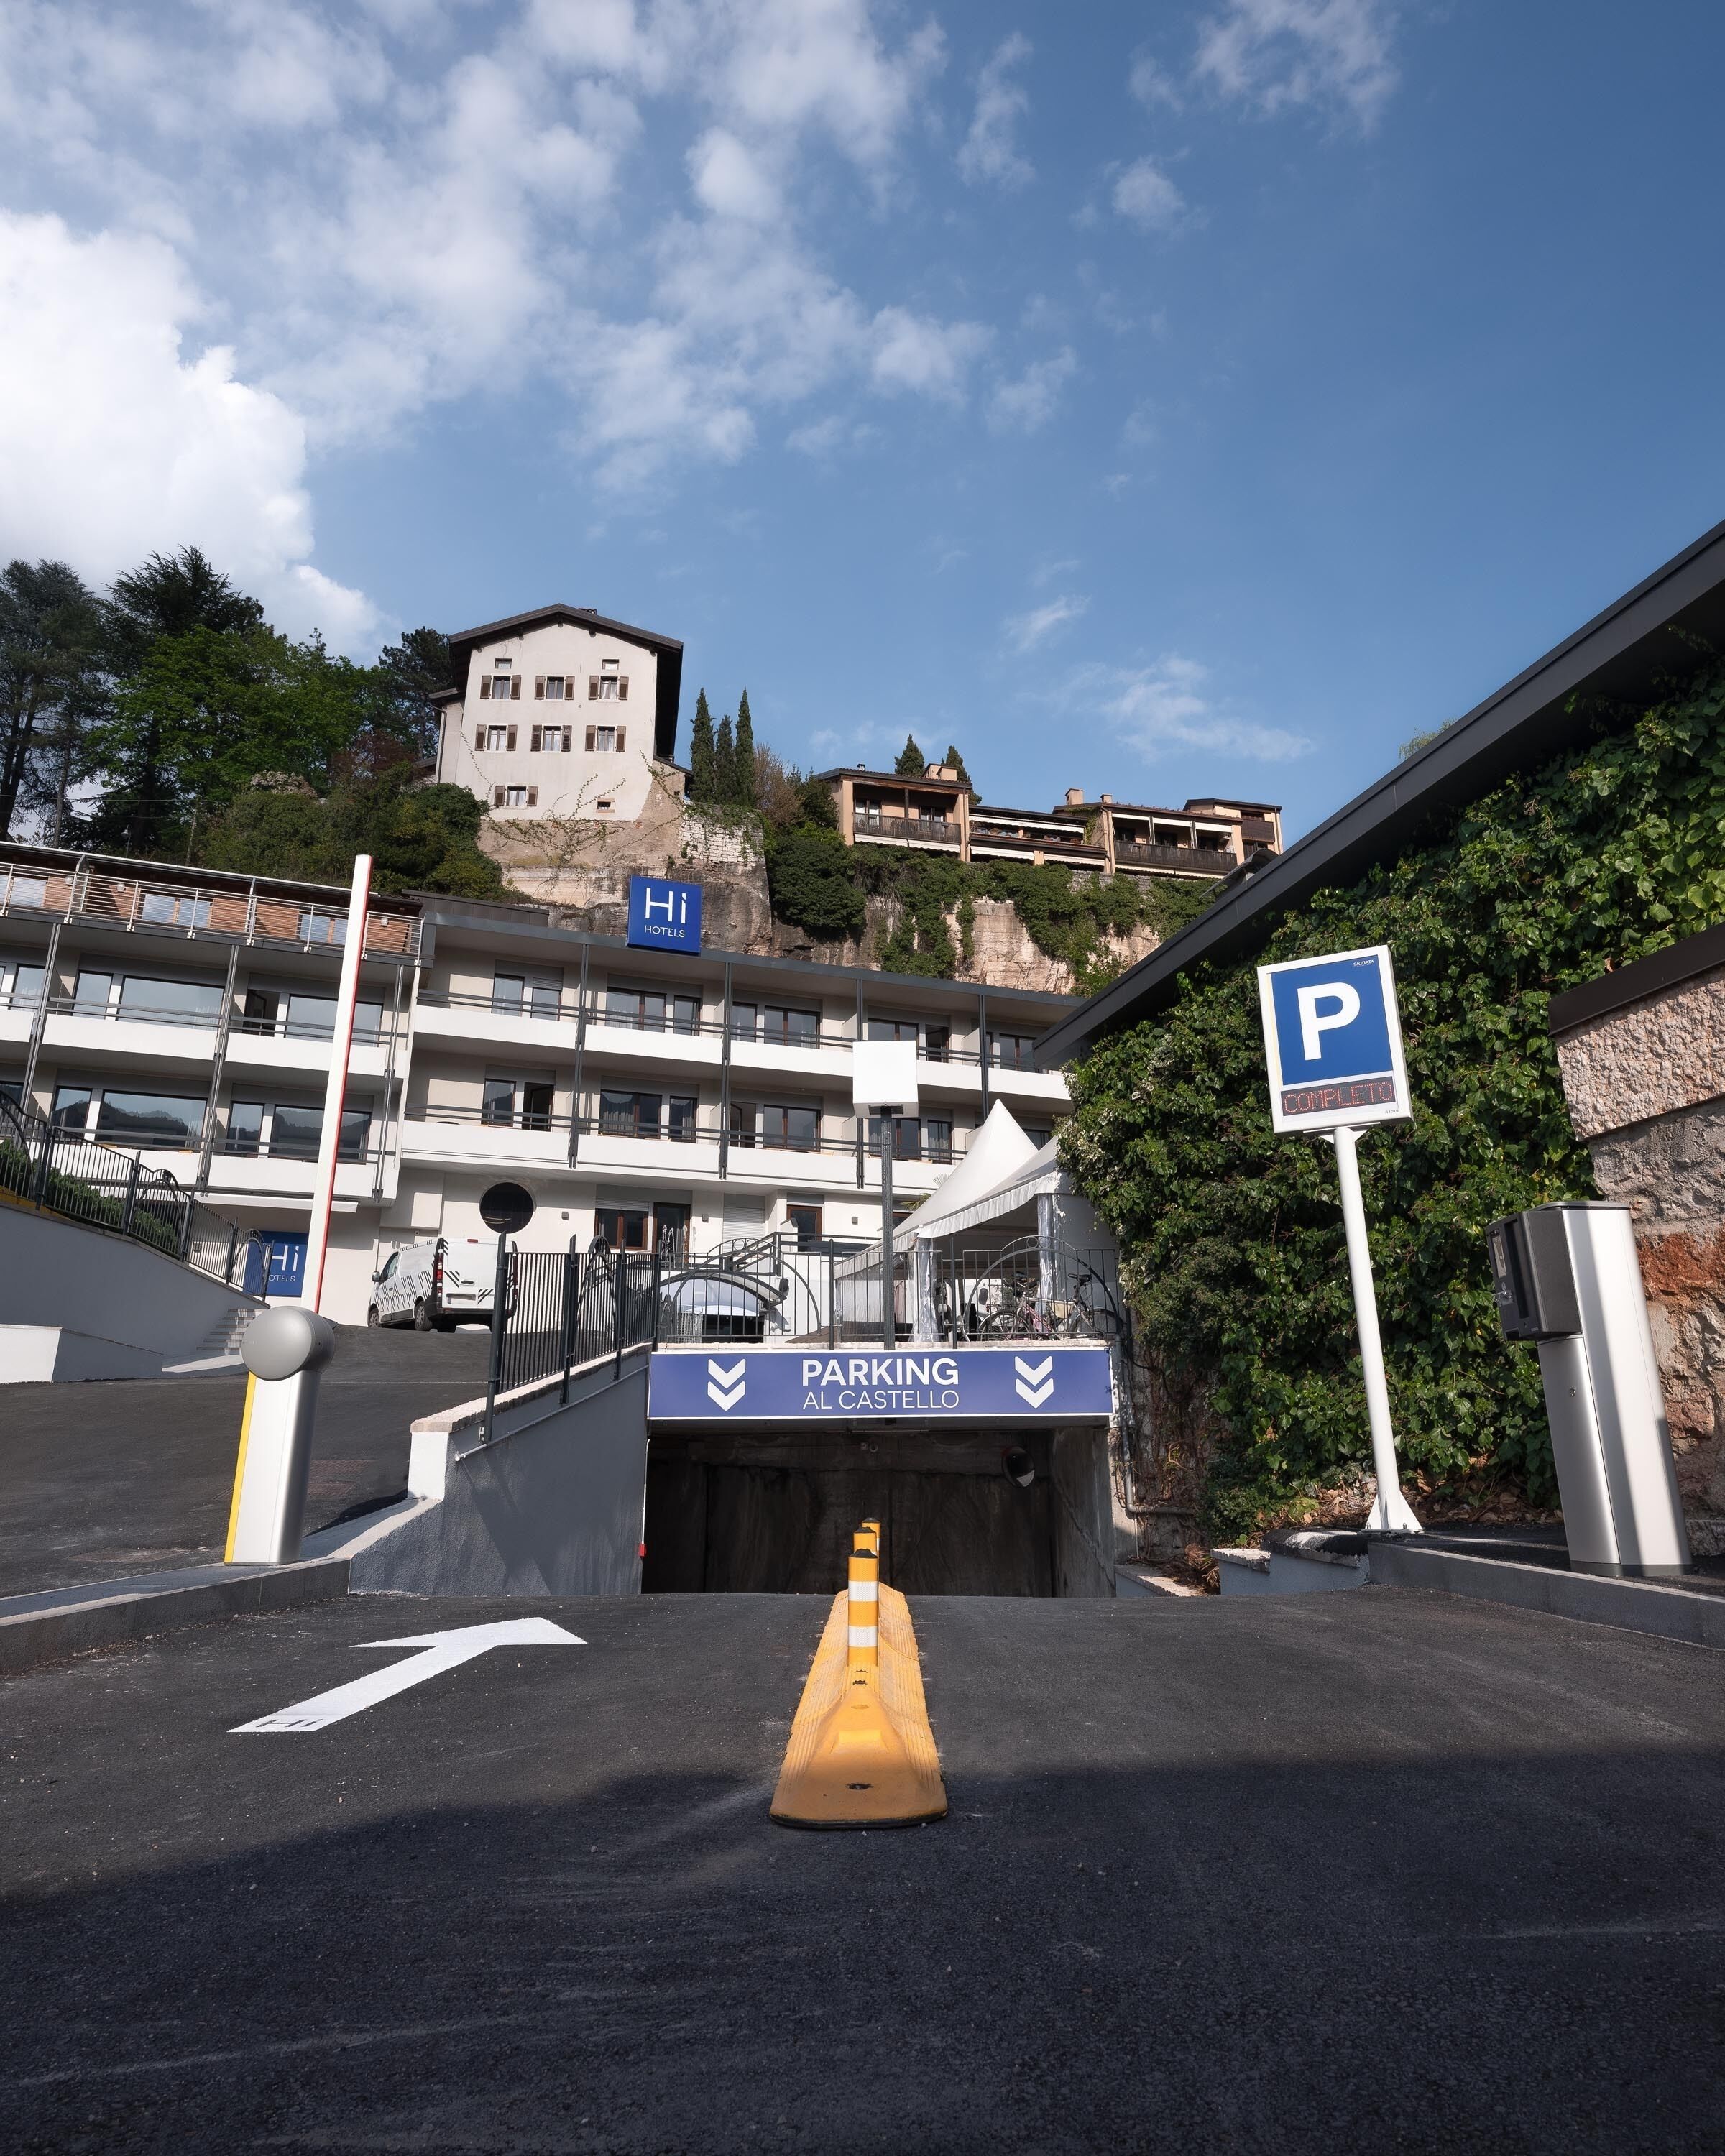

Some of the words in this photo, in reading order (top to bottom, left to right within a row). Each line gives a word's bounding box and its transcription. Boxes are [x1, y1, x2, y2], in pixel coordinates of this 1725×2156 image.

[645, 887, 686, 924] Hi
[644, 925, 685, 938] HOTELS
[1297, 982, 1361, 1061] P
[1283, 1081, 1393, 1113] COMPLETO
[802, 1357, 960, 1387] PARKING
[803, 1391, 832, 1410] AL
[838, 1389, 960, 1410] CASTELLO
